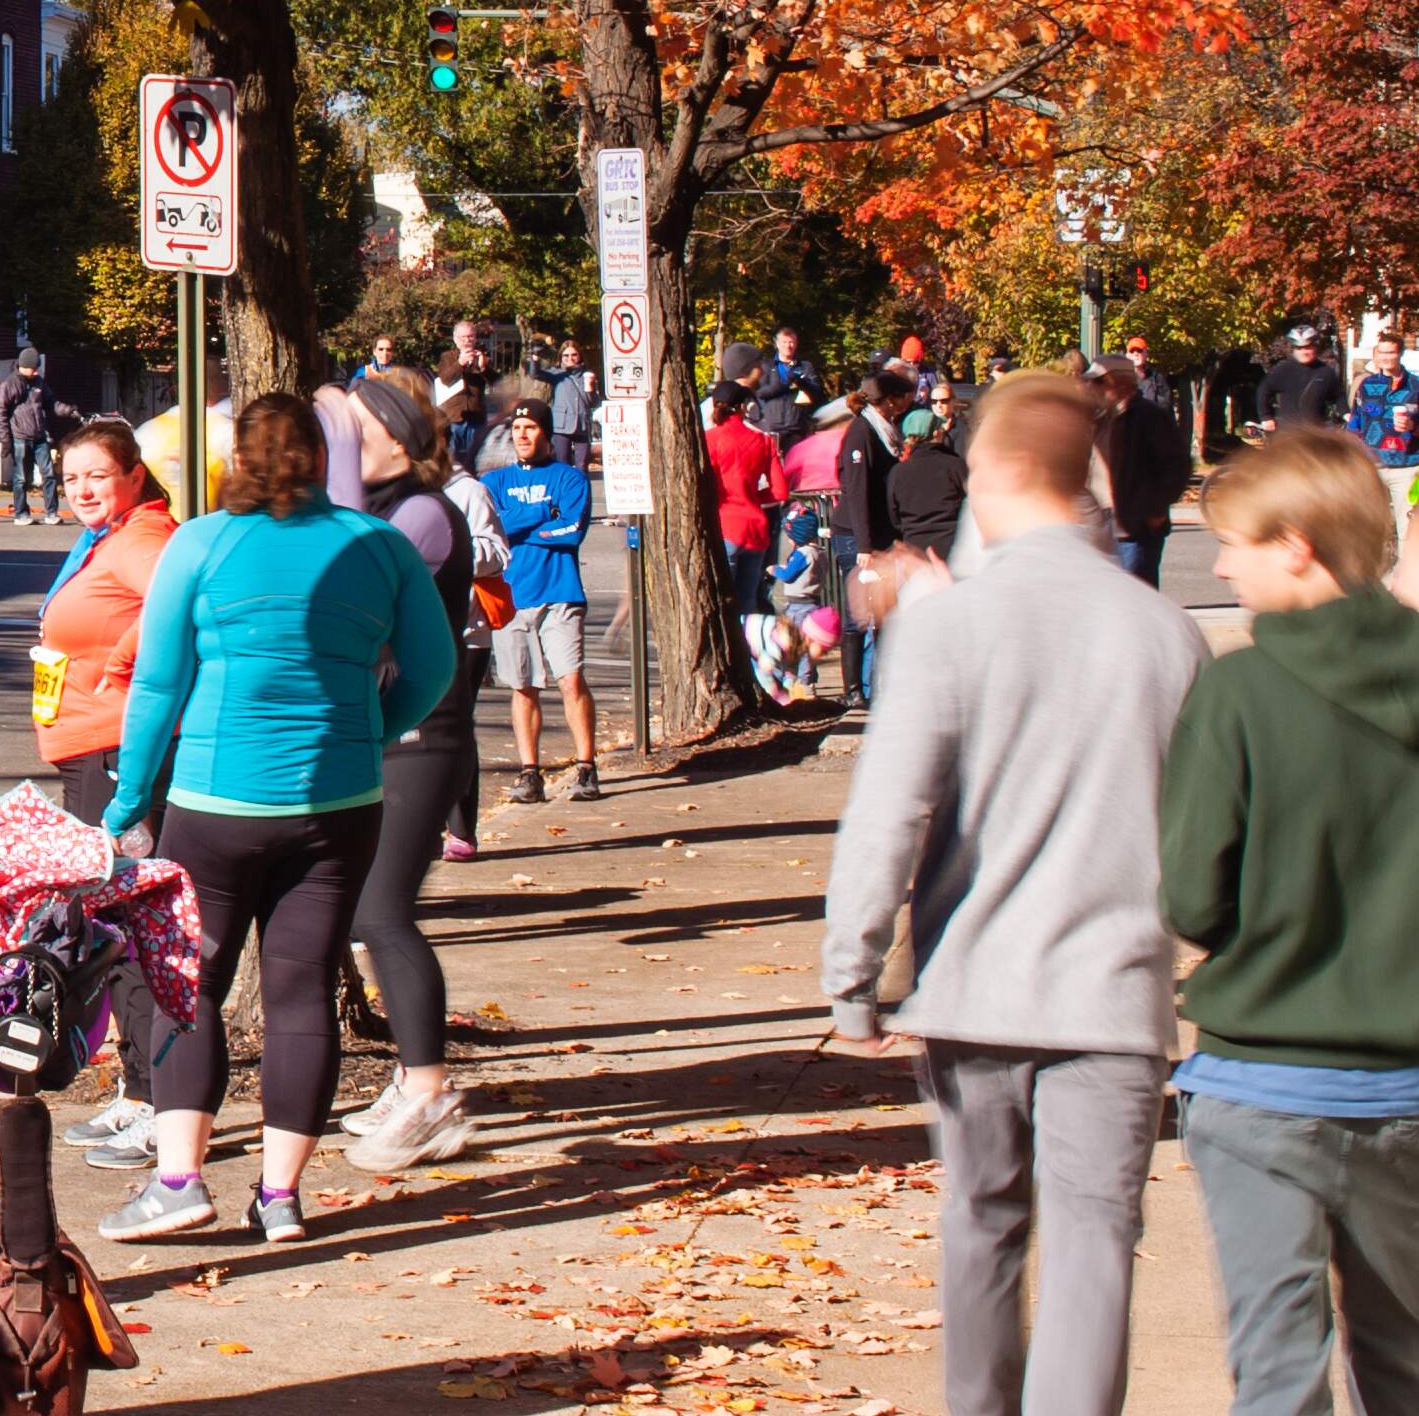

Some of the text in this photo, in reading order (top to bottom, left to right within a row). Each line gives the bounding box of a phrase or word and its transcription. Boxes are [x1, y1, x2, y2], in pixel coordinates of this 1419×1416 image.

[605, 180, 639, 192] BUS STOP
[608, 251, 640, 262] No Parking
